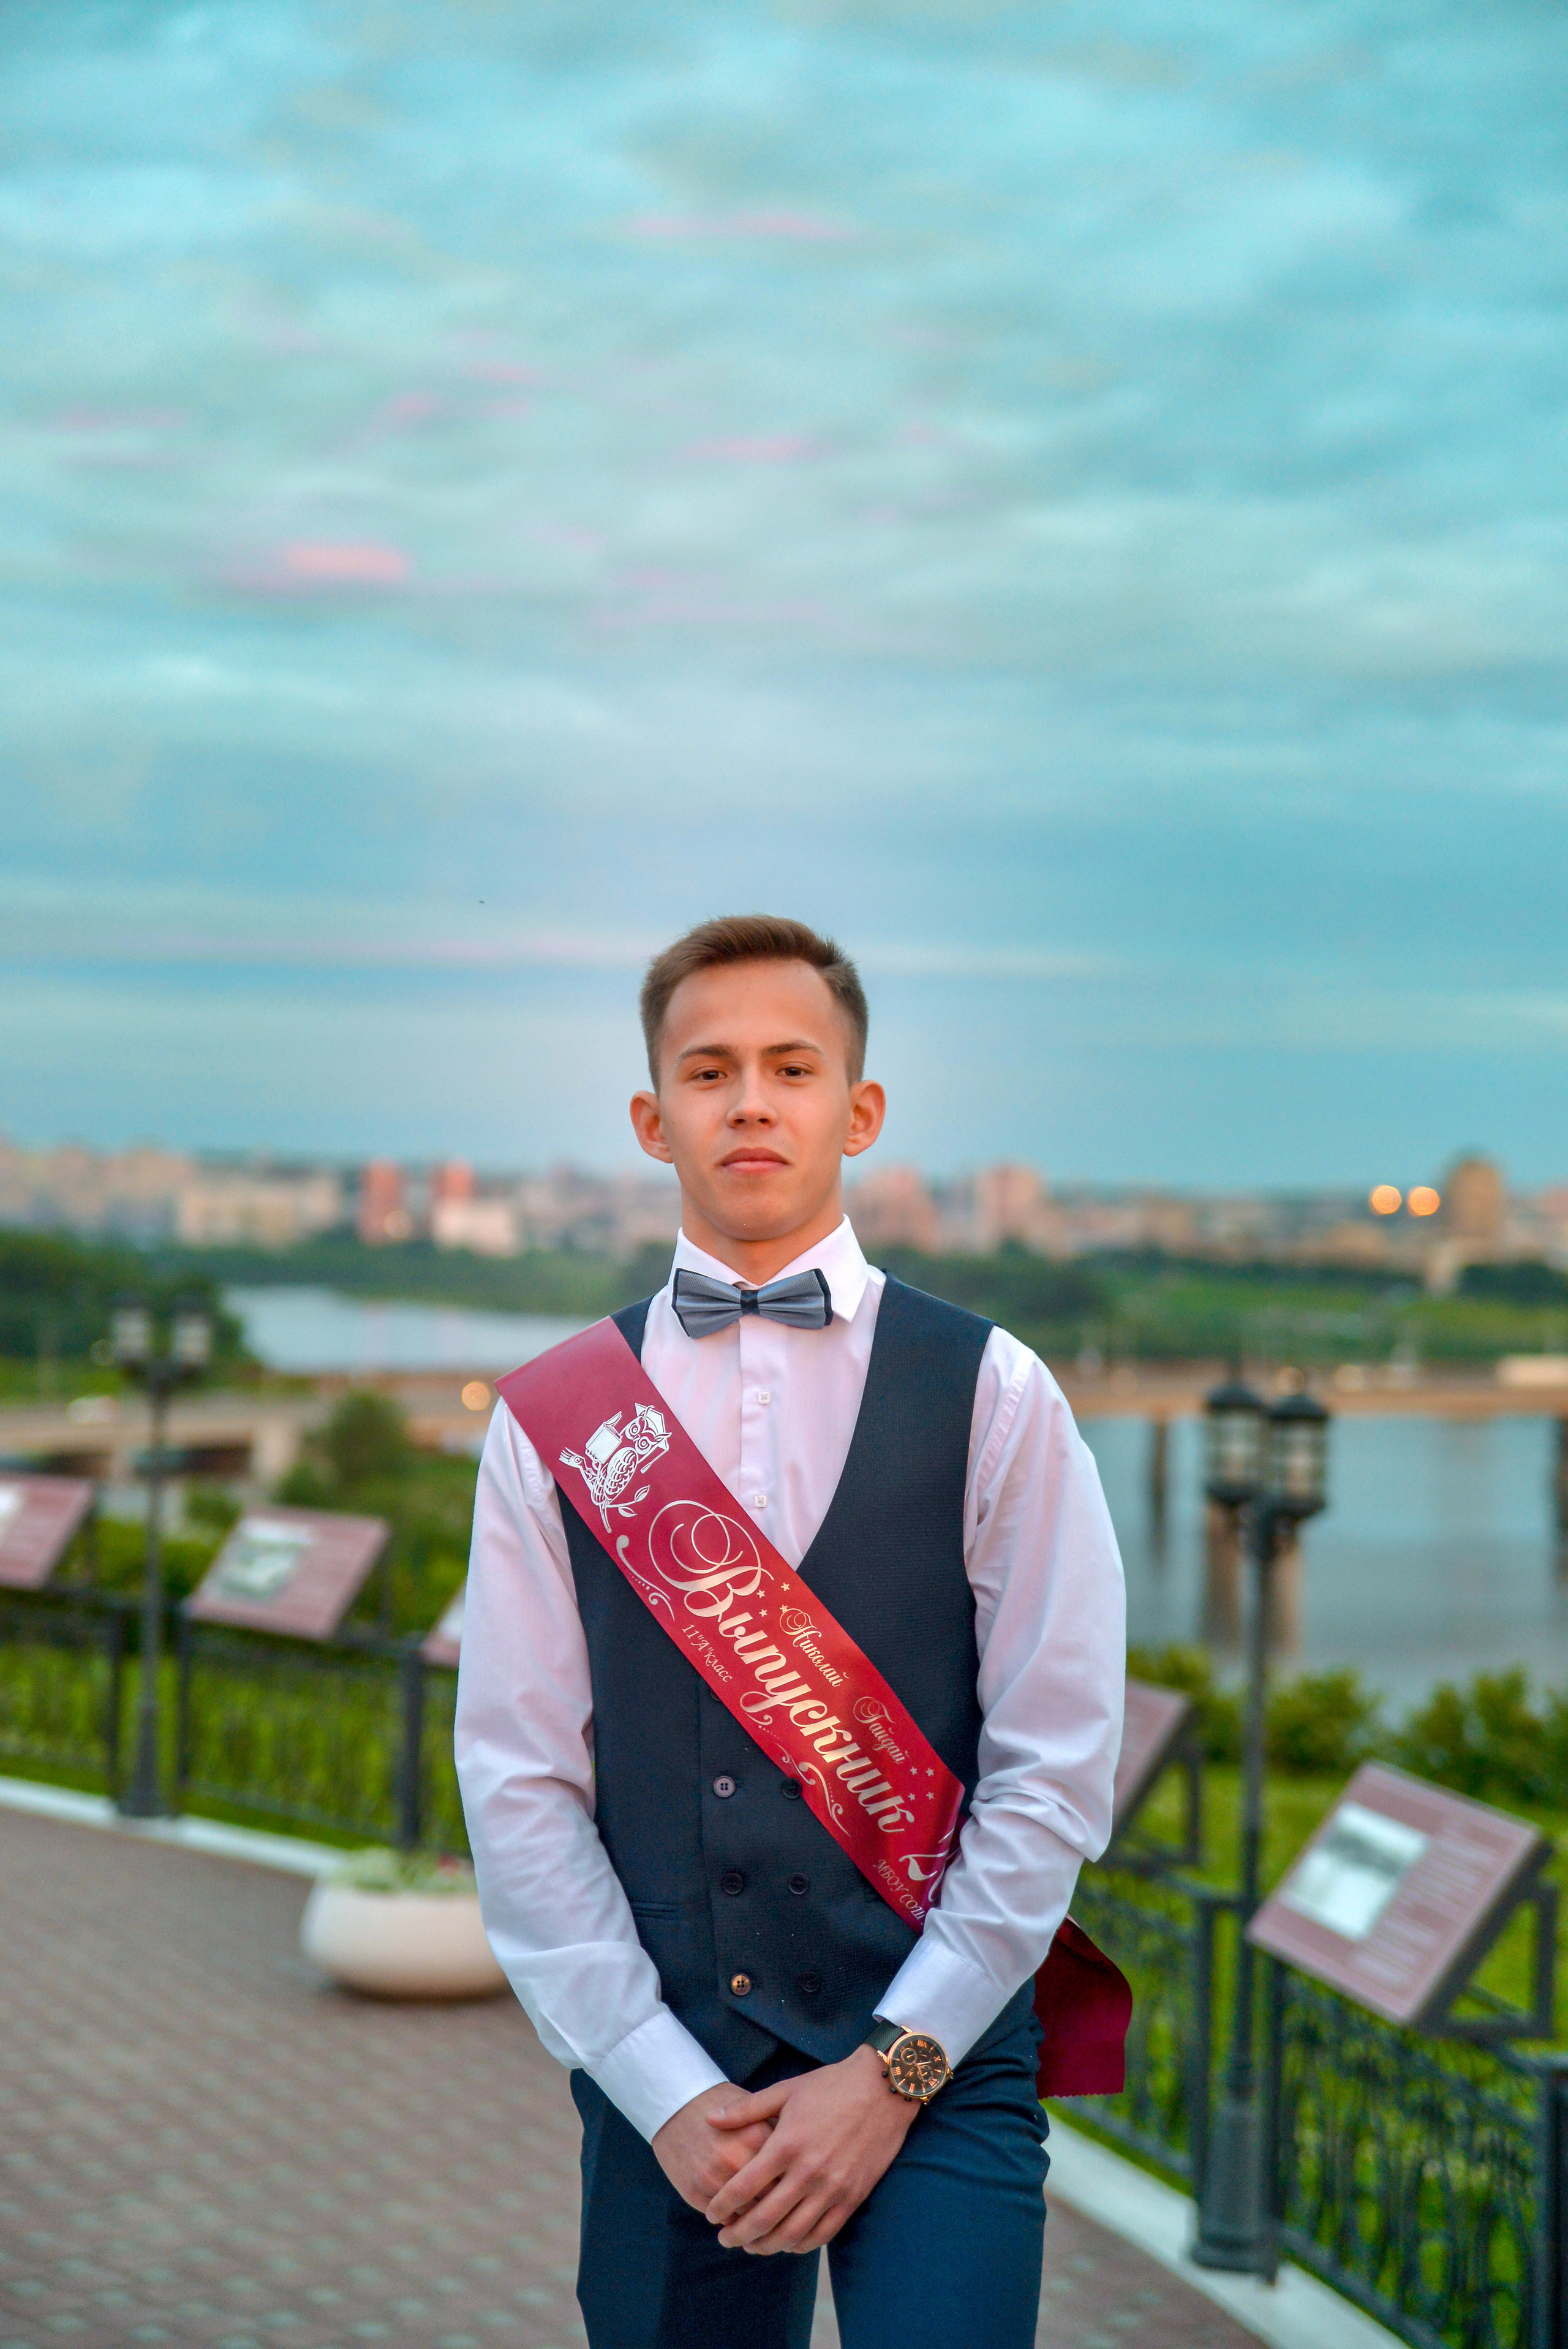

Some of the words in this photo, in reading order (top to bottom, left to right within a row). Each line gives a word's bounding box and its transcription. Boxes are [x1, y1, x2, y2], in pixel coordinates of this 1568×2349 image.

[649, 1500, 914, 1833] Выпускник
[779, 1608, 849, 1687] Николай
[853, 1696, 910, 1765] Гайдай
[873, 1859, 909, 1892] МБОУ
[899, 1894, 925, 1920] СОШ
